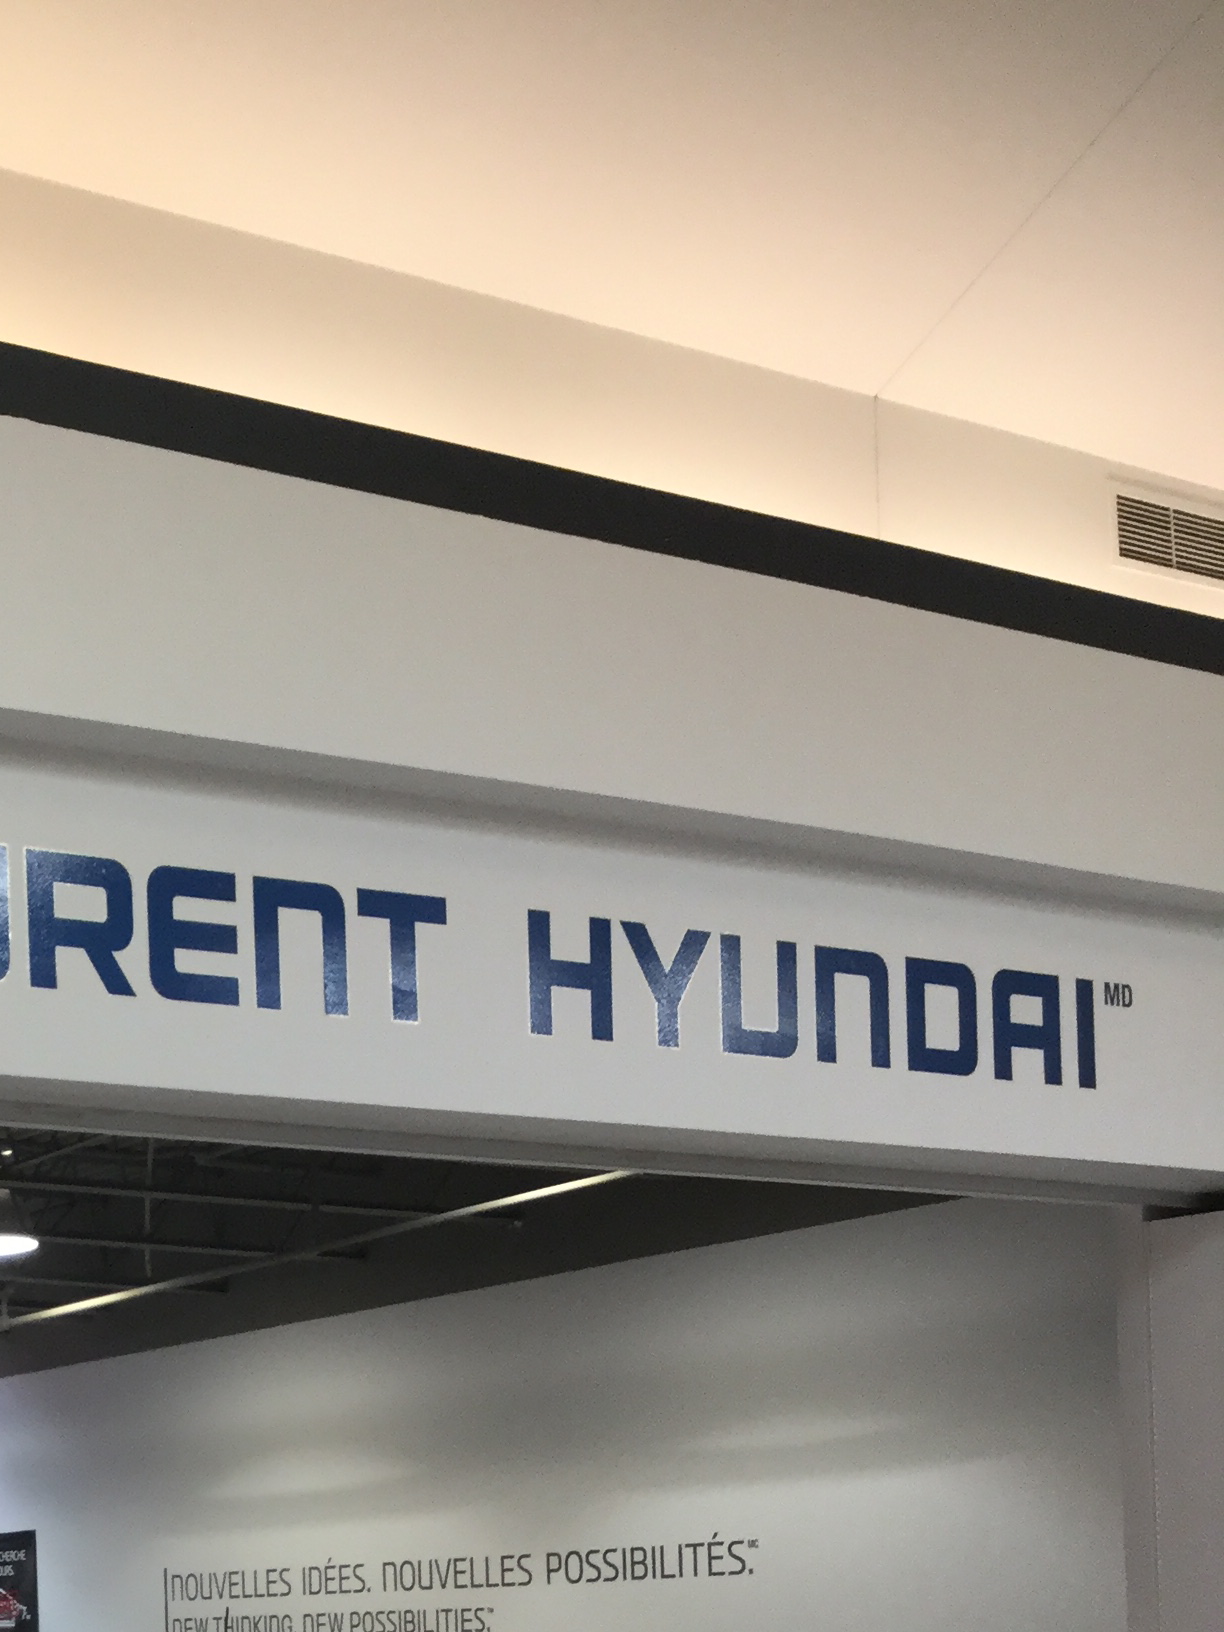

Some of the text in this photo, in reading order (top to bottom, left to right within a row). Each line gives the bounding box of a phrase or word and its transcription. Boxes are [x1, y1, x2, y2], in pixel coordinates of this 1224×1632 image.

[526, 907, 1098, 1089] HYUNDAI
[1103, 981, 1134, 1008] MD
[171, 1566, 292, 1601] NOUVELLES
[301, 1557, 372, 1597] IDÉES.
[382, 1554, 533, 1592] NOUVELLES
[546, 1532, 755, 1585] POSSIBILITÉS.
